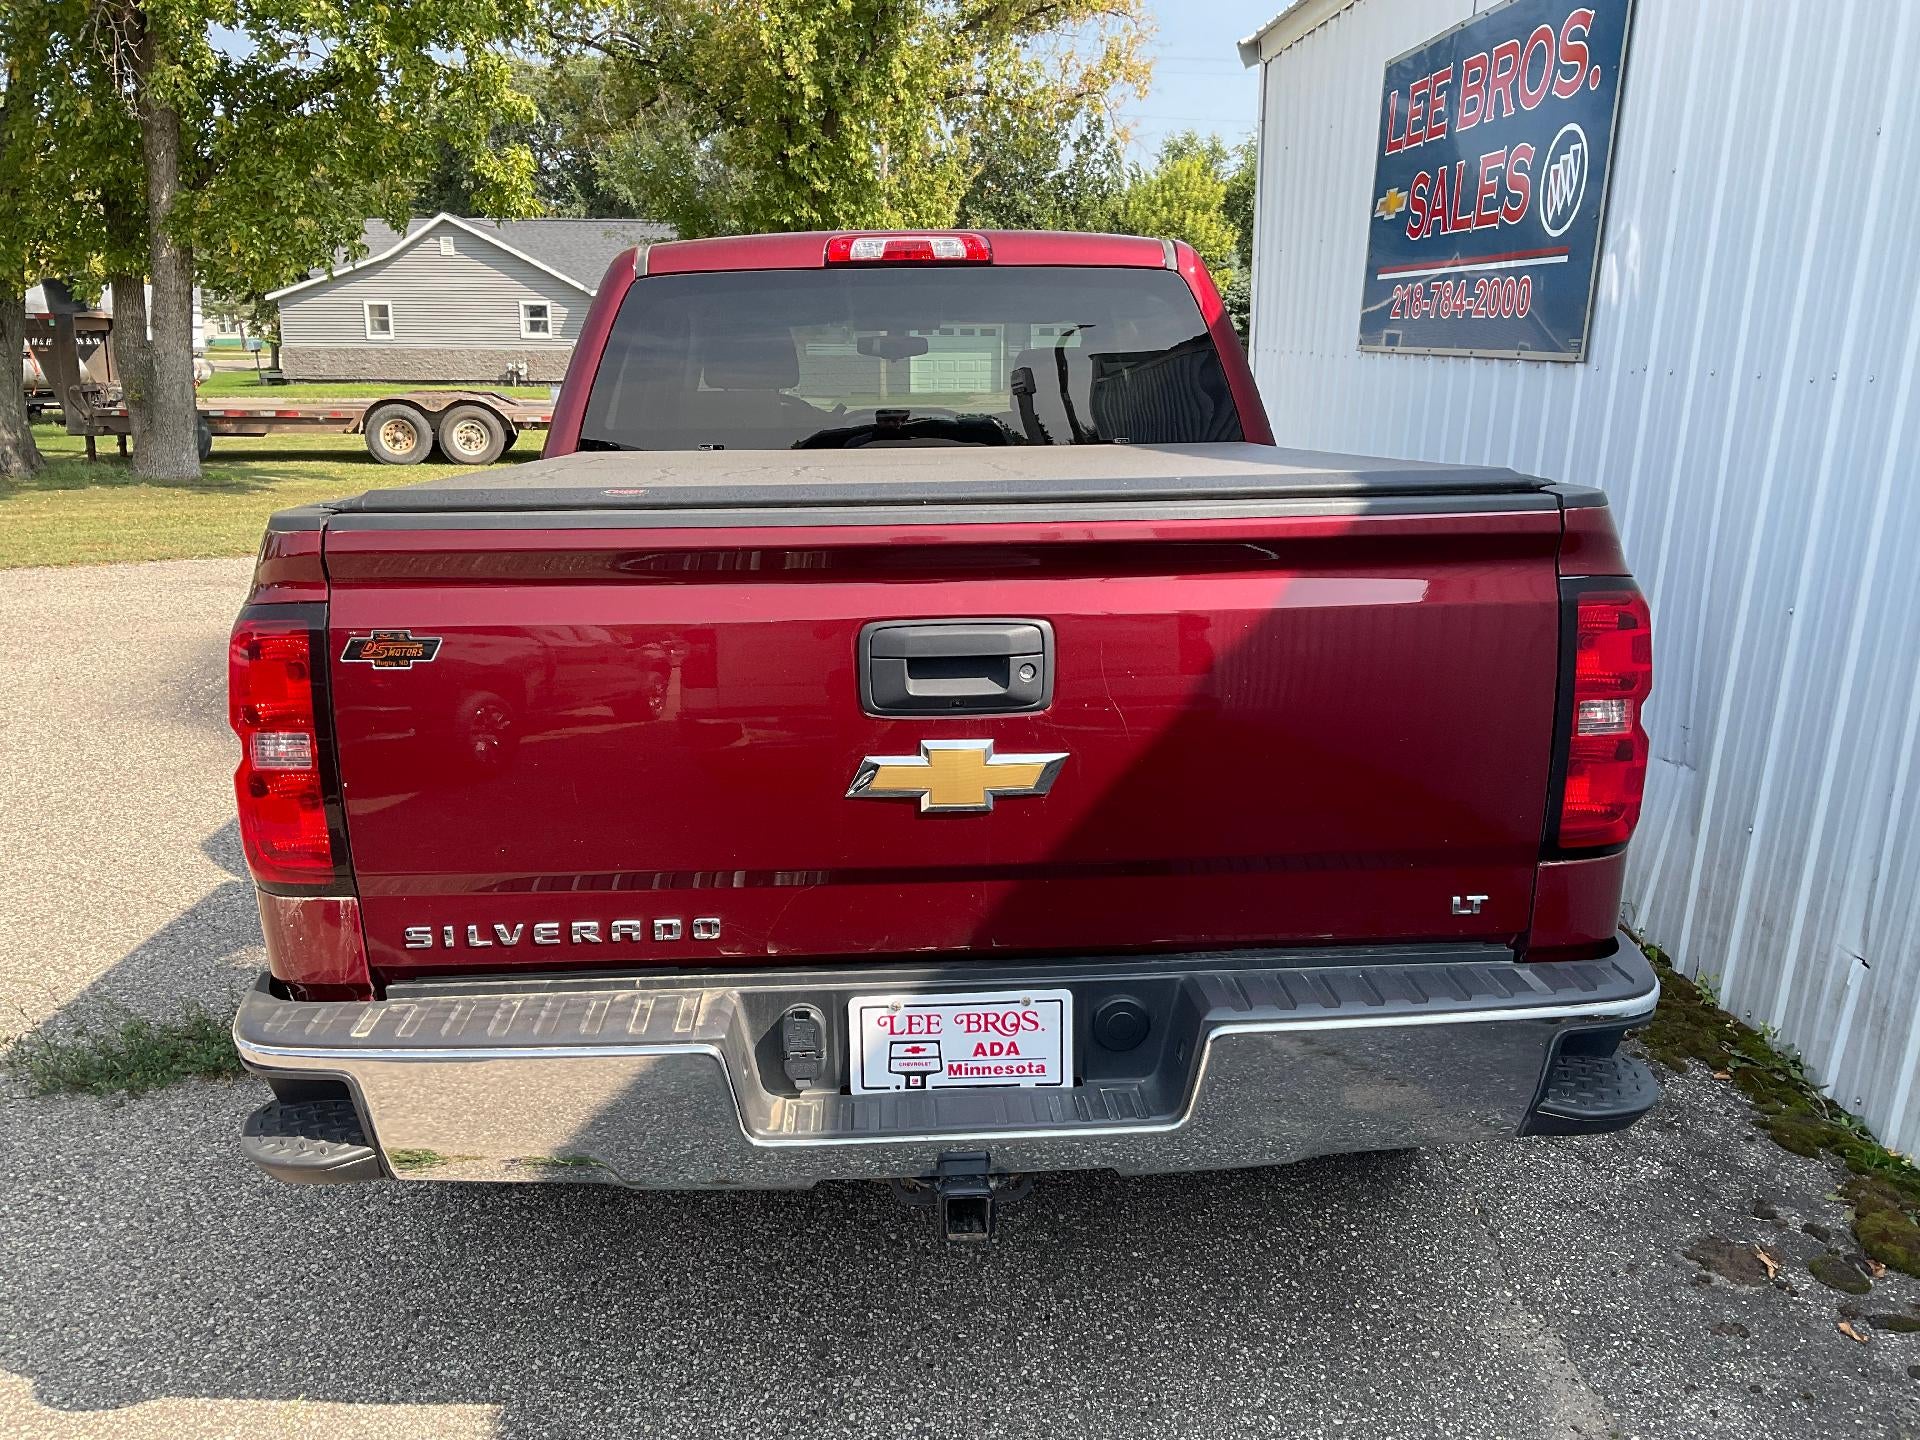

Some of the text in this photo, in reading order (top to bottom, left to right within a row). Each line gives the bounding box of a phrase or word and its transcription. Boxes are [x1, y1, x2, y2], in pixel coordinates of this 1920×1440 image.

[1385, 8, 1601, 155] LEE BROS.
[1406, 142, 1536, 240] SALES
[1390, 275, 1532, 320] 218-784-2000
[388, 648, 424, 657] MOTORS
[1452, 895, 1489, 915] LT
[405, 918, 721, 949] SILVERADO
[877, 1010, 1046, 1037] LEE BROS.
[972, 1041, 1021, 1057] ADA
[947, 1061, 1047, 1077] Minnesota
